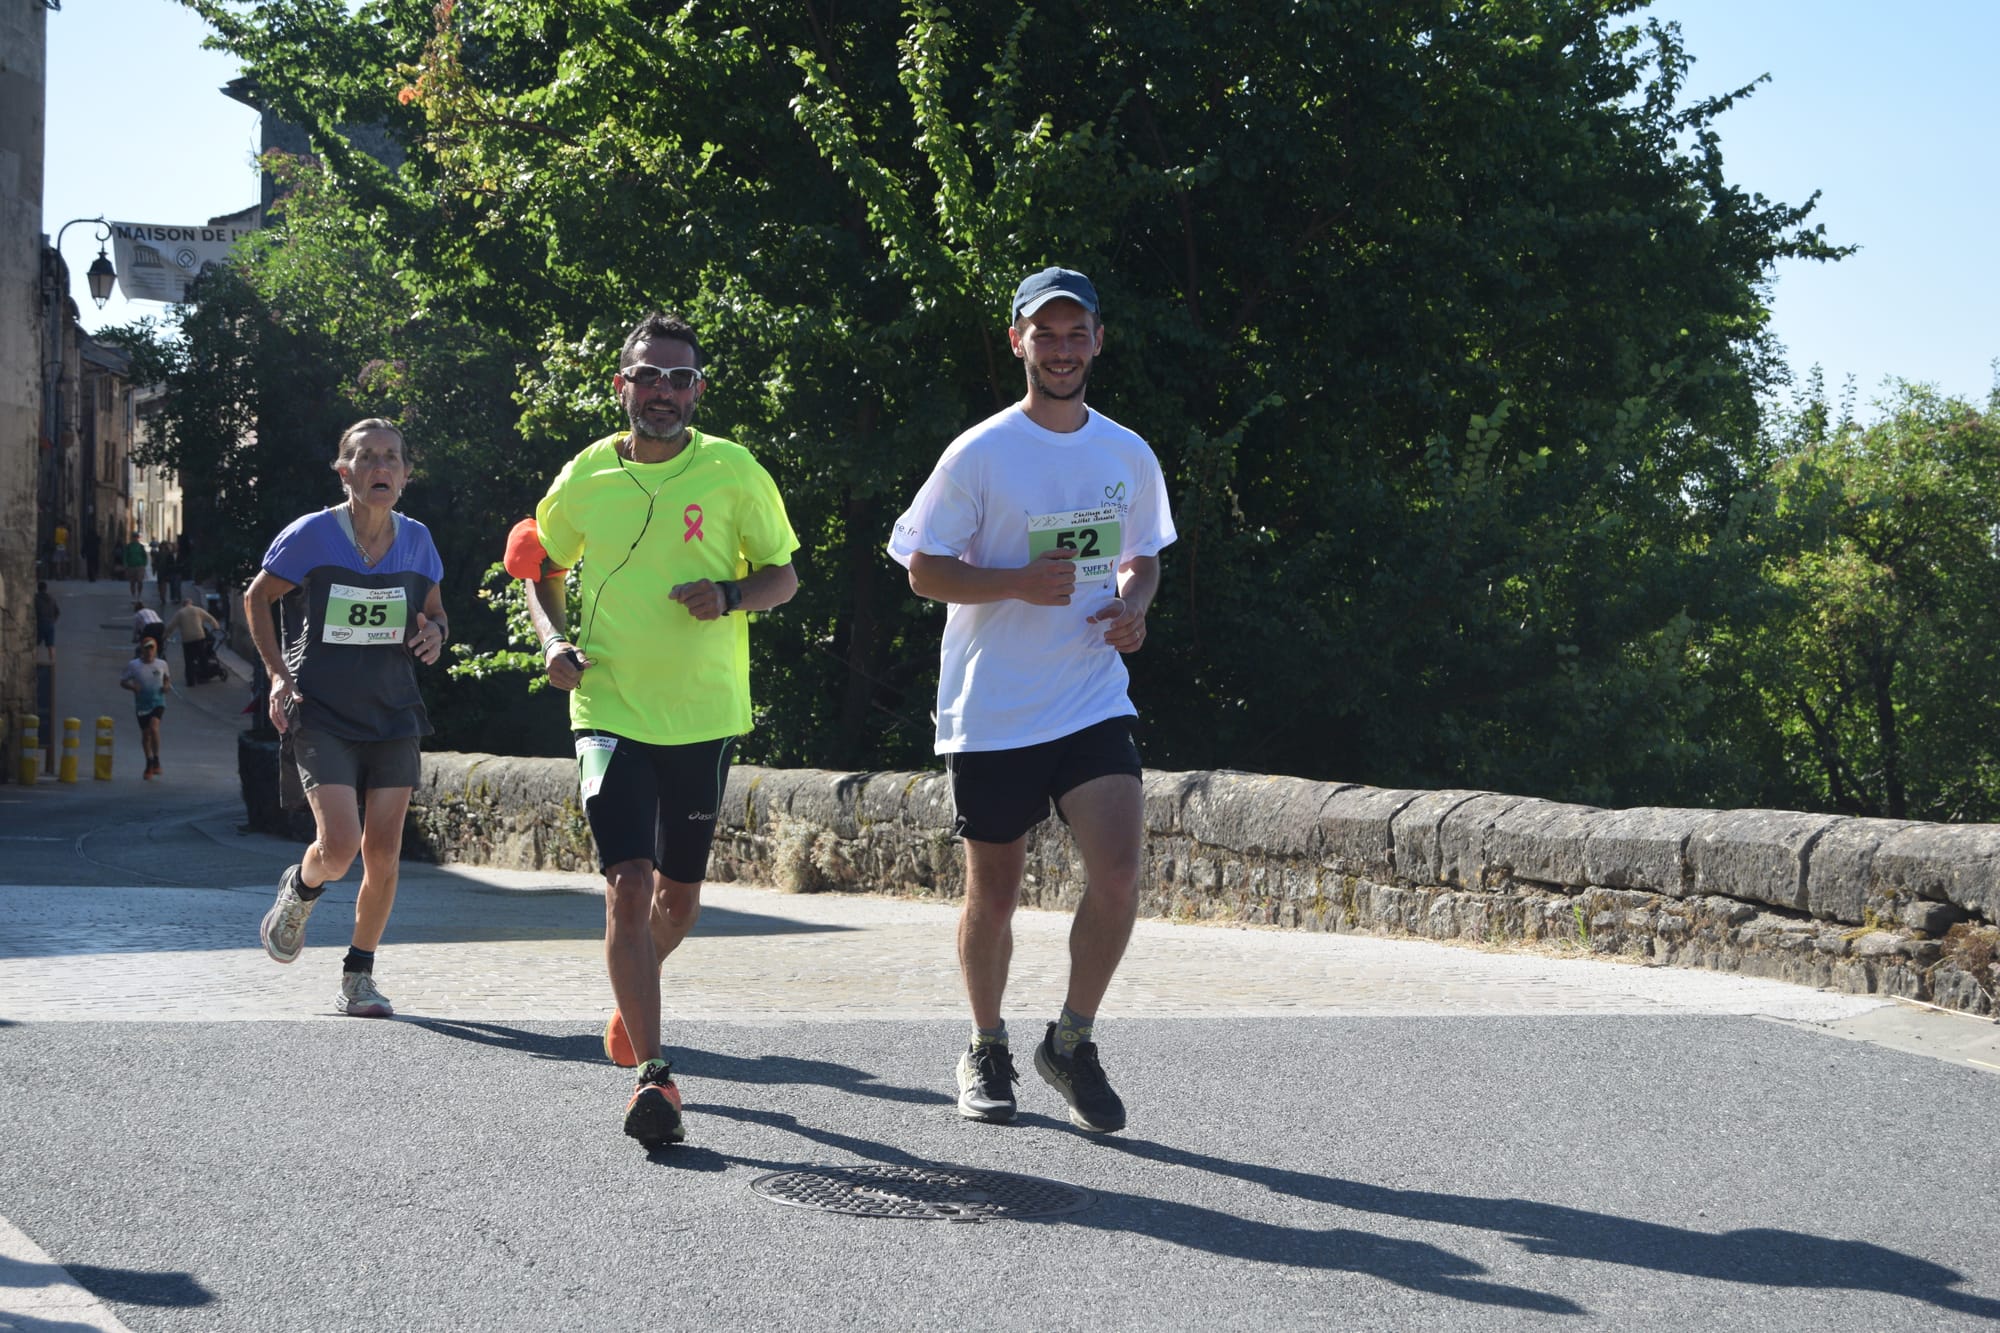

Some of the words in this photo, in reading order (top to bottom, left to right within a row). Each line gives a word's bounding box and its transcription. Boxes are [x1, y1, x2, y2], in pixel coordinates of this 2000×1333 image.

[118, 227, 195, 241] MAISON
[202, 230, 226, 241] DE
[1056, 528, 1100, 557] 52
[348, 603, 387, 626] 85
